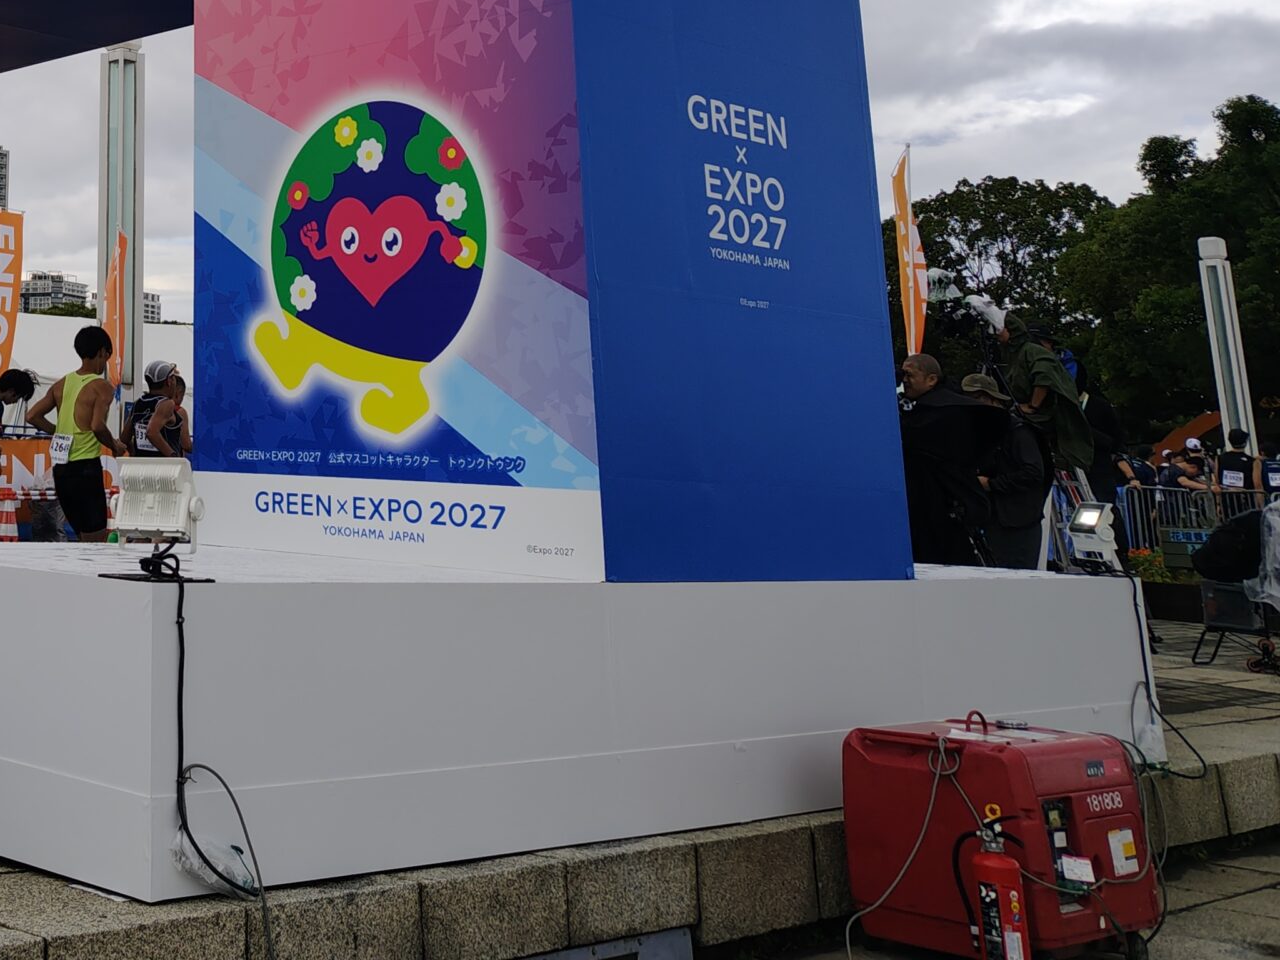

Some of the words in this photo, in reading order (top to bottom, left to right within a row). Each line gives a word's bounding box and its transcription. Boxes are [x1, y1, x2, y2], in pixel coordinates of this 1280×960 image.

[687, 94, 788, 150] GREEN
[704, 163, 785, 212] EXPO
[707, 204, 788, 250] 2027
[709, 246, 761, 266] YOKOHAMA
[763, 256, 790, 271] JAPAN
[297, 451, 321, 463] 2027
[328, 452, 439, 468] 公式マスコットキャラクター
[448, 456, 527, 473] トゥンクトゥンク
[430, 500, 507, 530] 2027
[322, 525, 385, 541] YOKOHAMA
[388, 528, 425, 544] JAPAN
[554, 545, 575, 557] 2027
[1086, 791, 1124, 812] 181808
